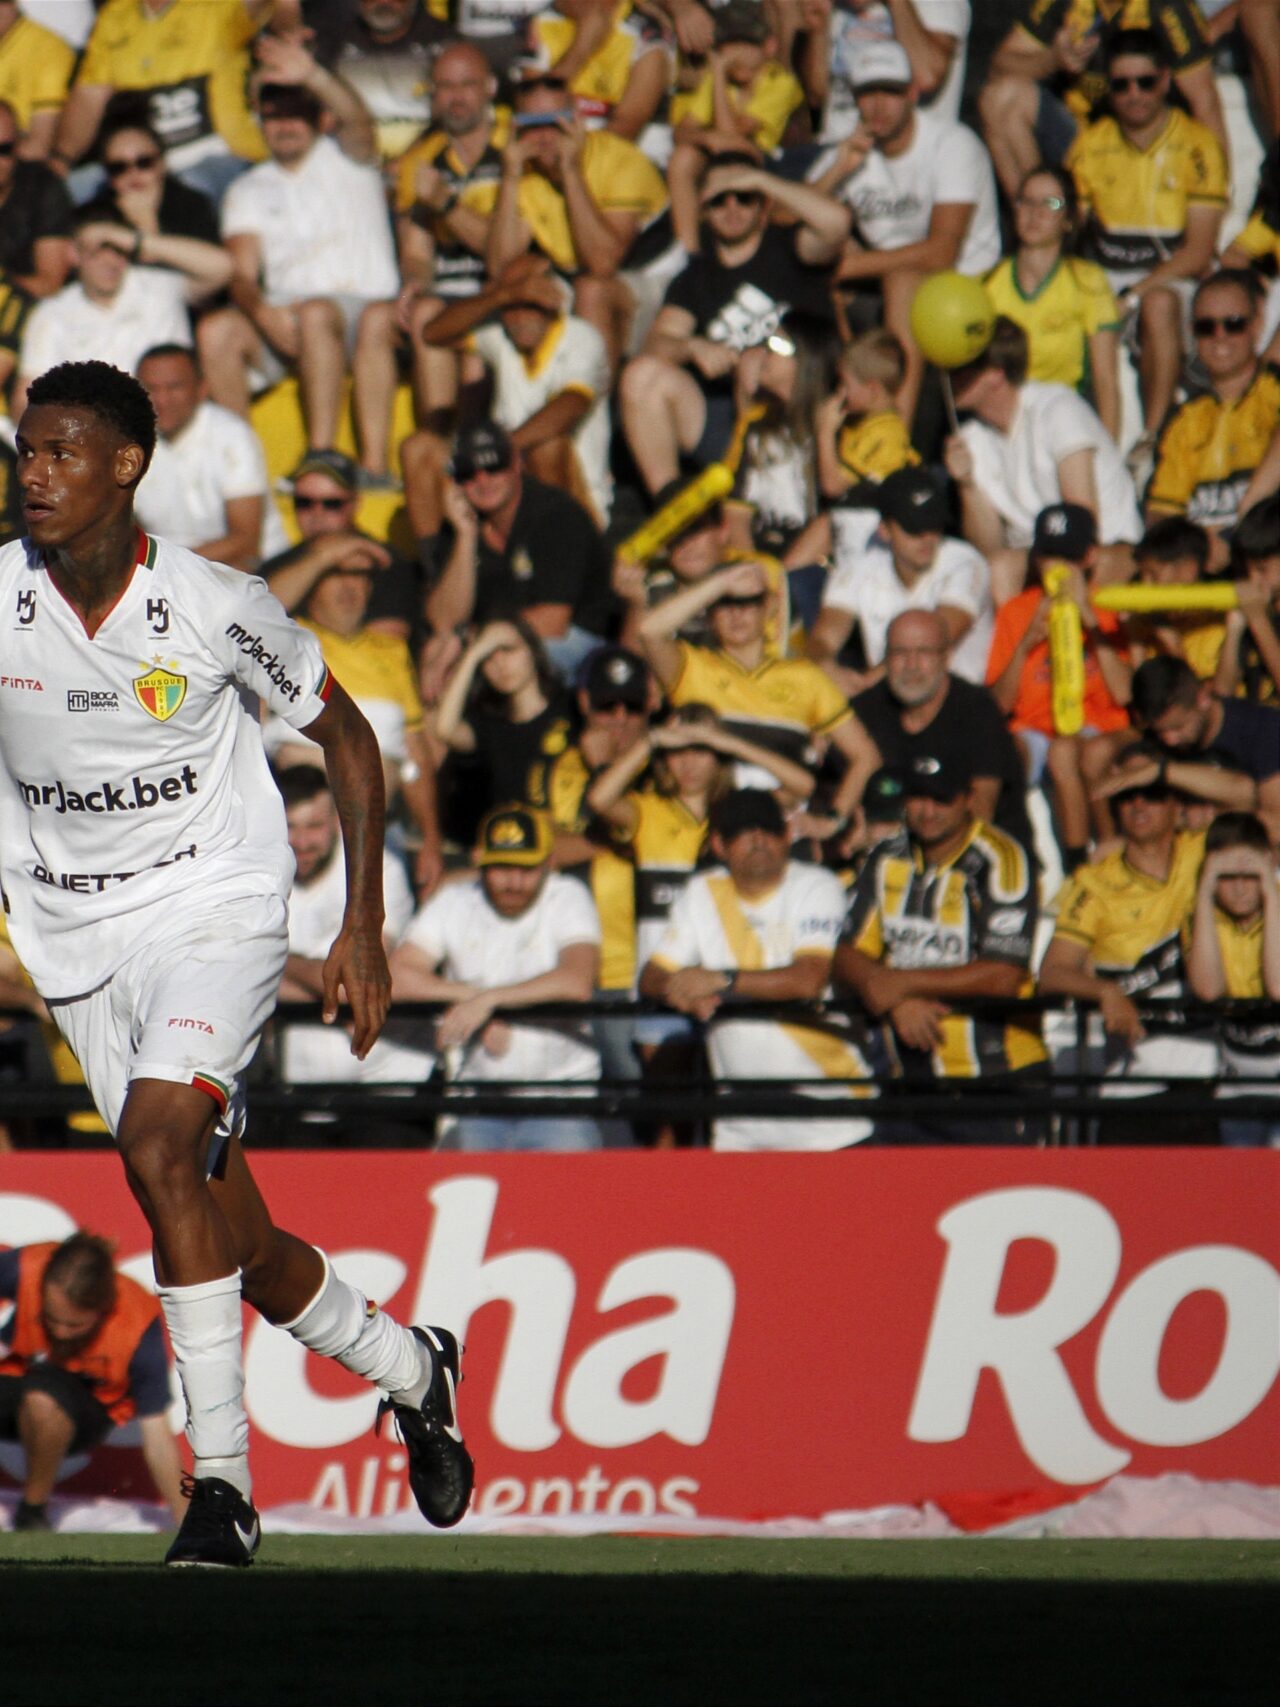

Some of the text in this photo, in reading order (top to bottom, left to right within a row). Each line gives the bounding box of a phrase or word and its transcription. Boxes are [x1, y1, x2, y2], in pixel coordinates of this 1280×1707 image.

[225, 622, 302, 703] mrJack.bet
[137, 678, 183, 688] BRUSQUE
[90, 691, 119, 701] BOCA
[90, 700, 120, 708] MAFRA
[17, 764, 198, 814] mrJack.bet
[167, 1018, 215, 1035] FINTA
[308, 1453, 702, 1520] Alientos
